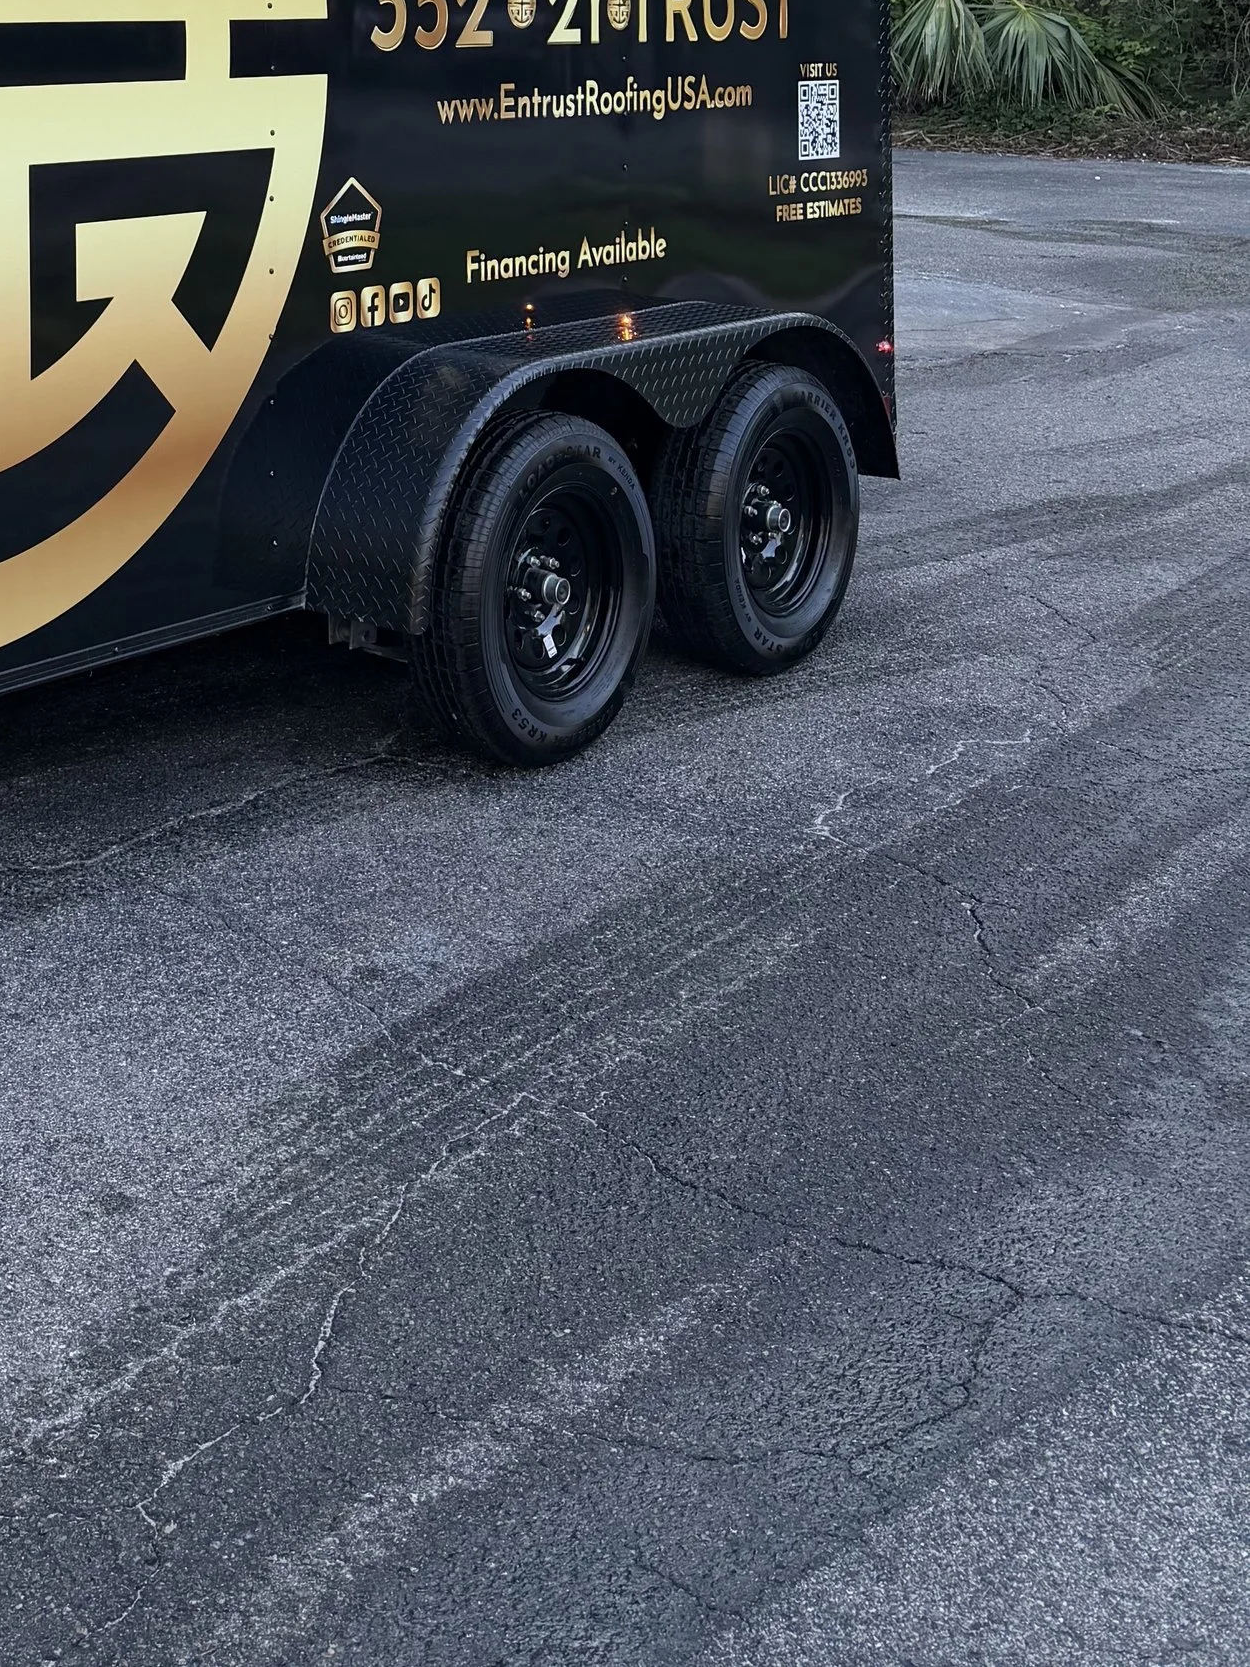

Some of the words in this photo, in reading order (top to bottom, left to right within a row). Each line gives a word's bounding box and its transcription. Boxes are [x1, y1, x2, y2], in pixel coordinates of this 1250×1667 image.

[800, 63, 823, 78] VISIT
[826, 63, 838, 77] US
[437, 74, 752, 125] www.EntrustRoofingUSA.com
[768, 174, 797, 196] LIC#
[800, 169, 868, 192] CCC1336993
[776, 203, 804, 222] FREE
[806, 197, 862, 219] ESTIMATES
[328, 235, 376, 248] CREDENTIALED
[465, 247, 570, 284] Financing
[577, 226, 667, 270] Available
[512, 708, 548, 743] KR53
